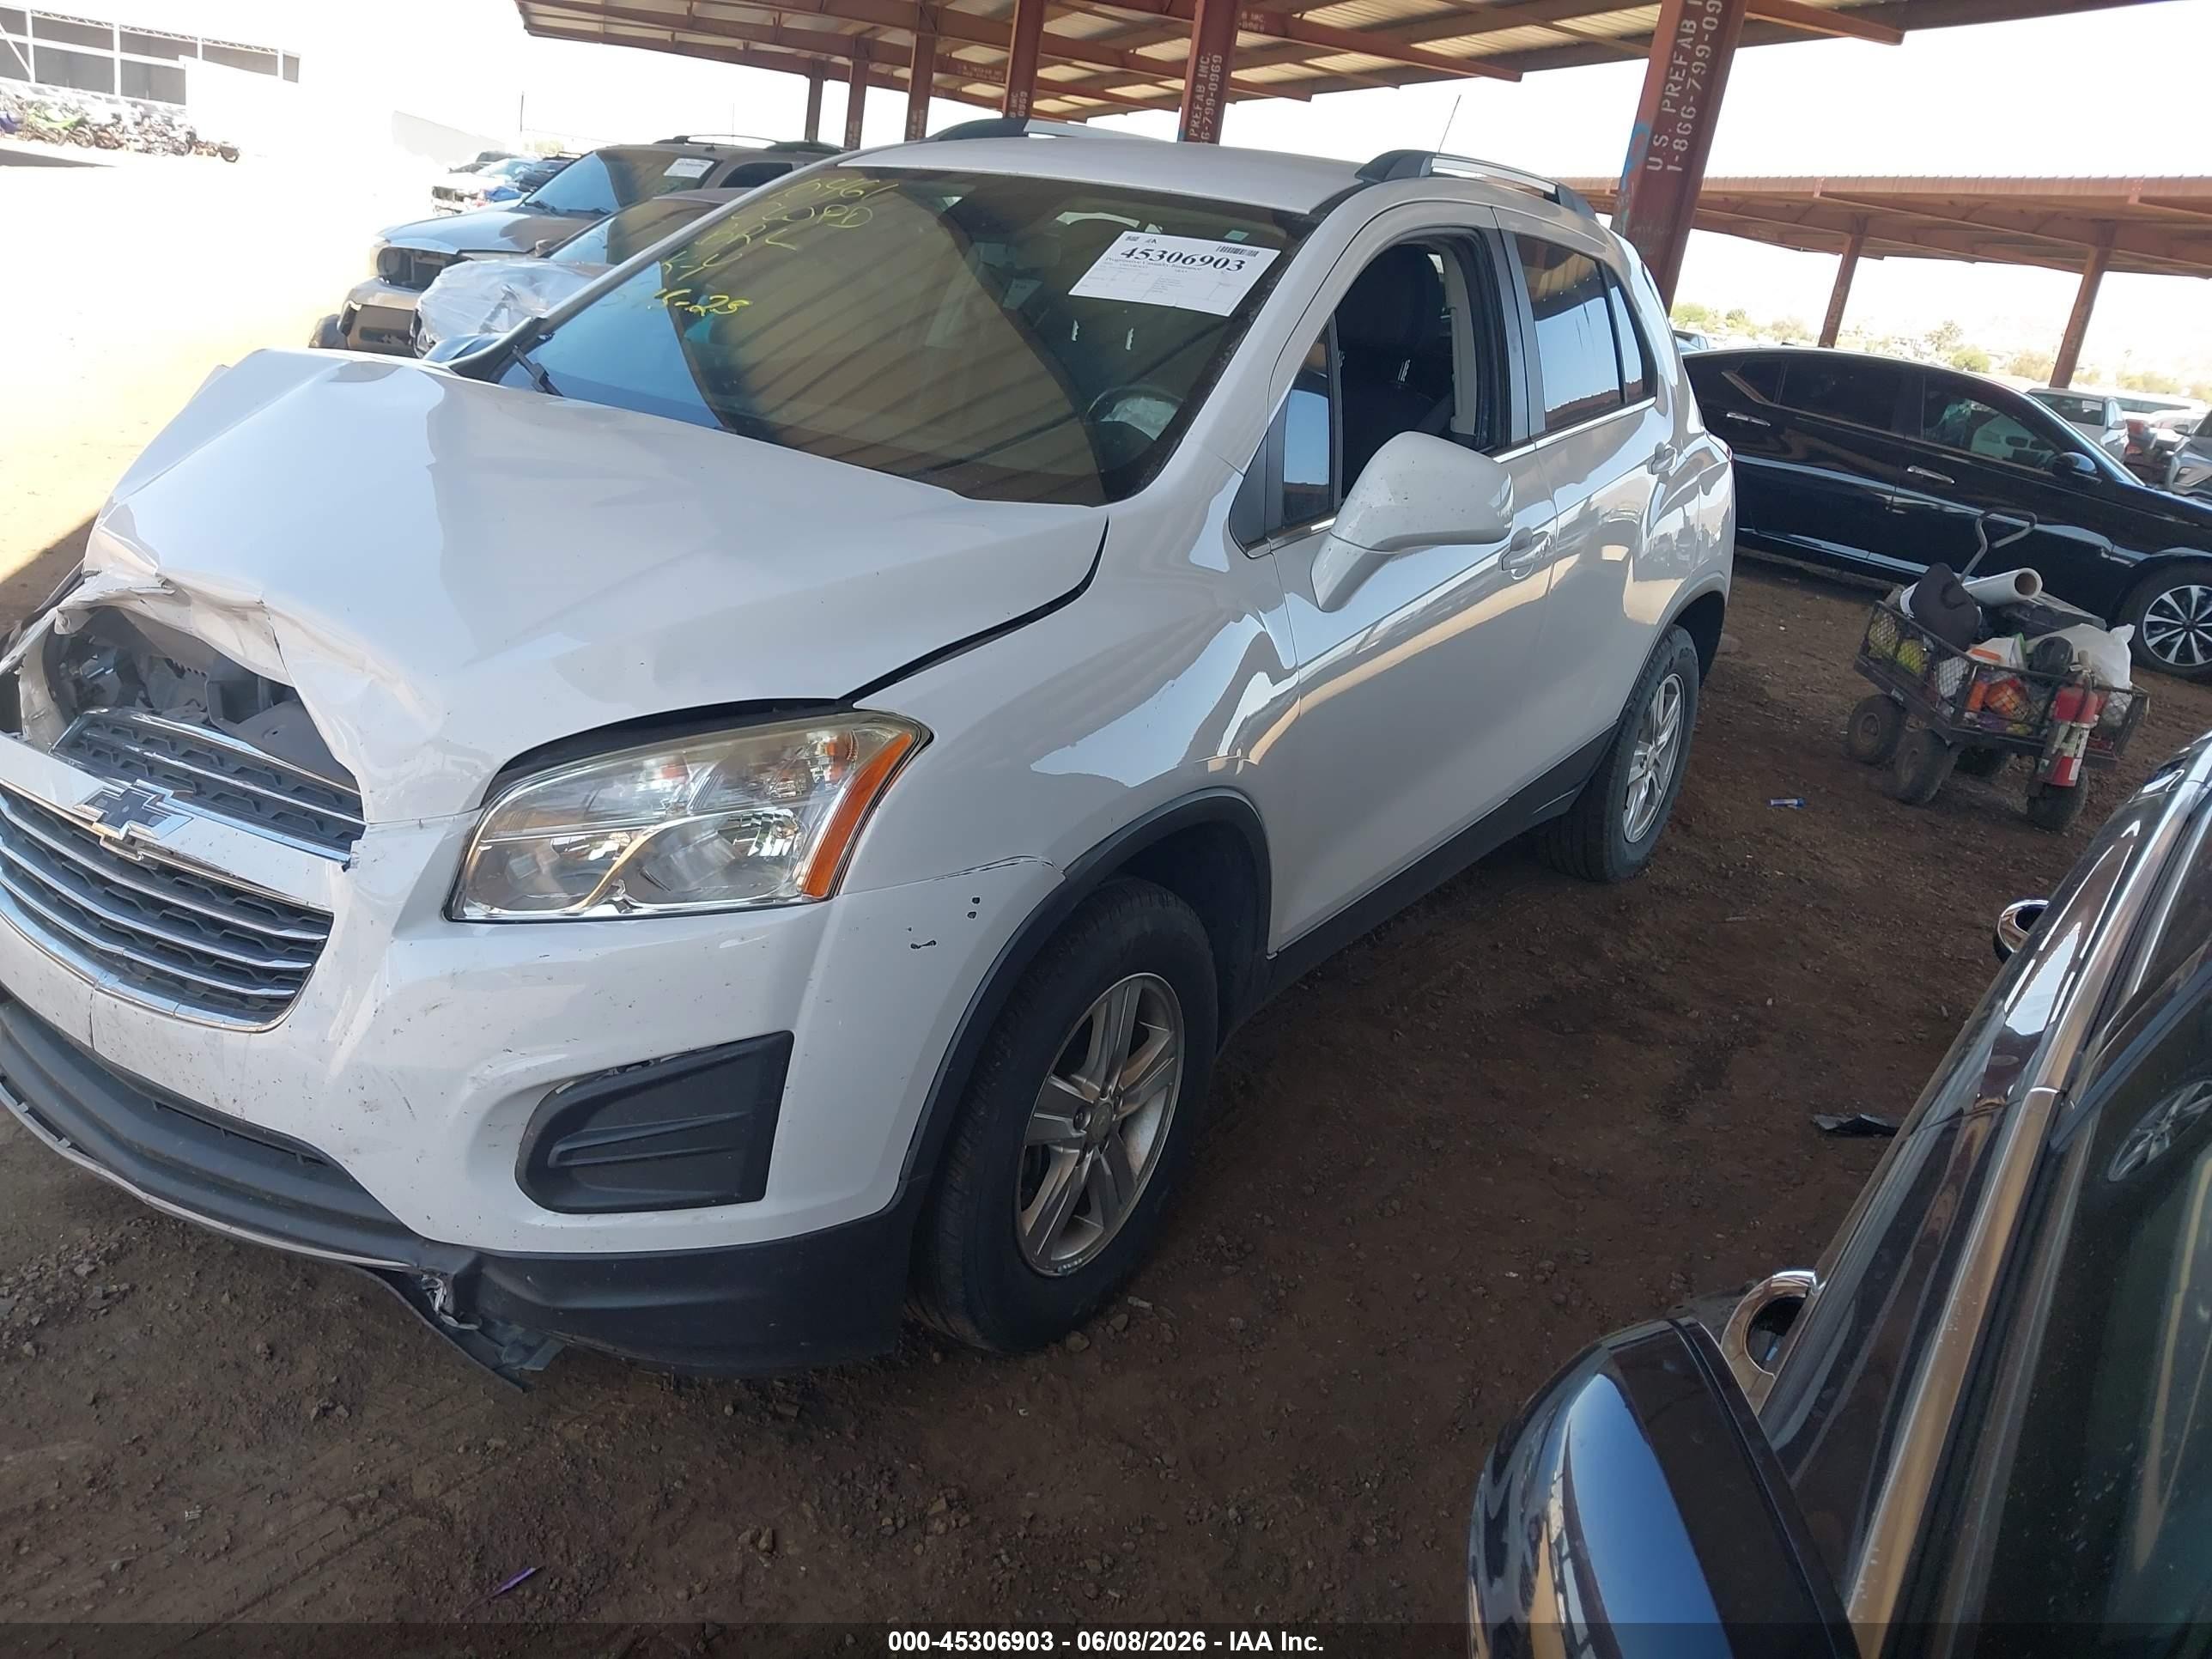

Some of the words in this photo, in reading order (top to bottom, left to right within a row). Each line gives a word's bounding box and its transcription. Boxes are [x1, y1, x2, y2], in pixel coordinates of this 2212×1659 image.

[1661, 19, 1697, 112] PREFAB
[1188, 84, 1206, 137] PREFAB
[1120, 246, 1246, 273] 45306903
